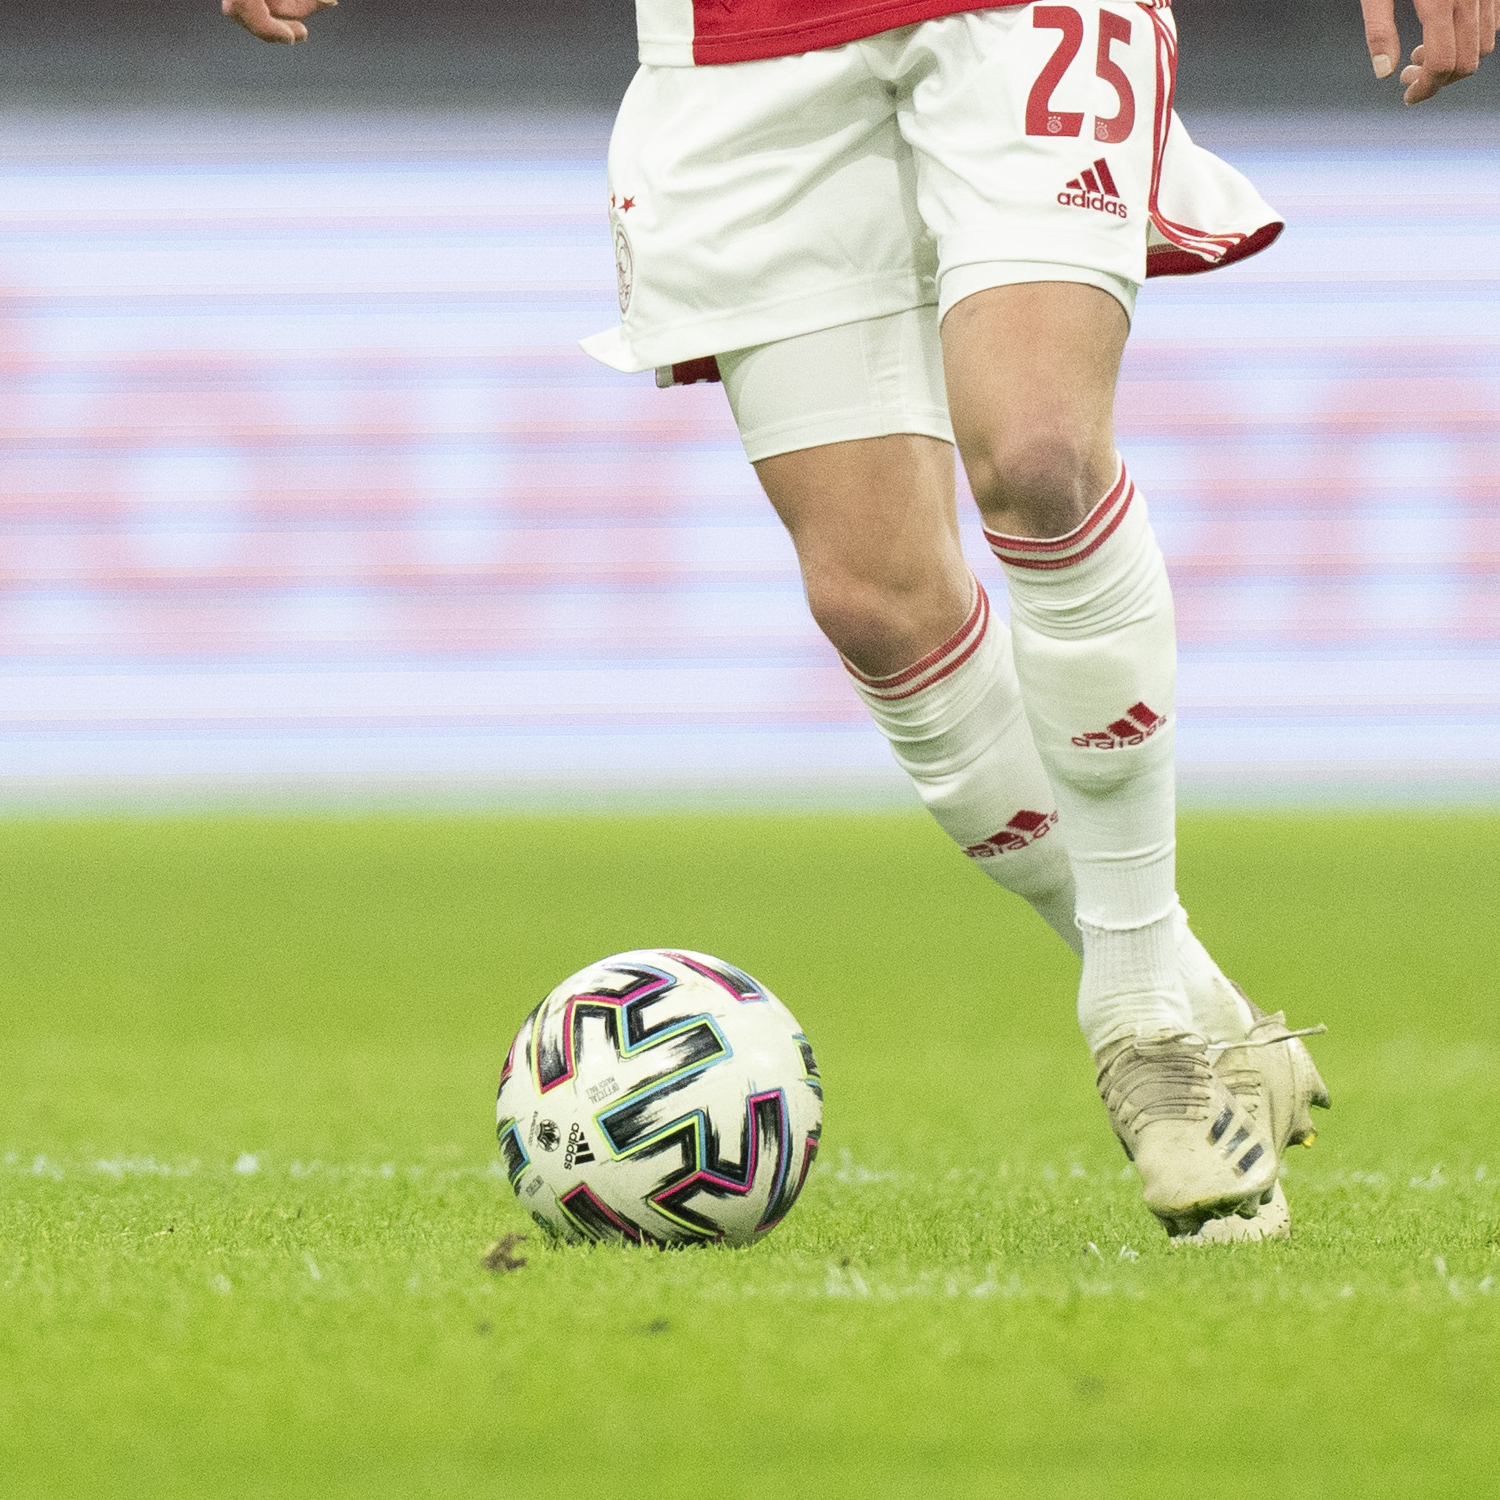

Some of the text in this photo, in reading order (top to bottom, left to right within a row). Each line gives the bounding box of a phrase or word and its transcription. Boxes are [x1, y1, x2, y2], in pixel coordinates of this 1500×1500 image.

[1025, 5, 1135, 144] 25
[1057, 190, 1127, 218] adidas
[1071, 714, 1167, 750] adidas
[564, 1122, 580, 1171] adidas
